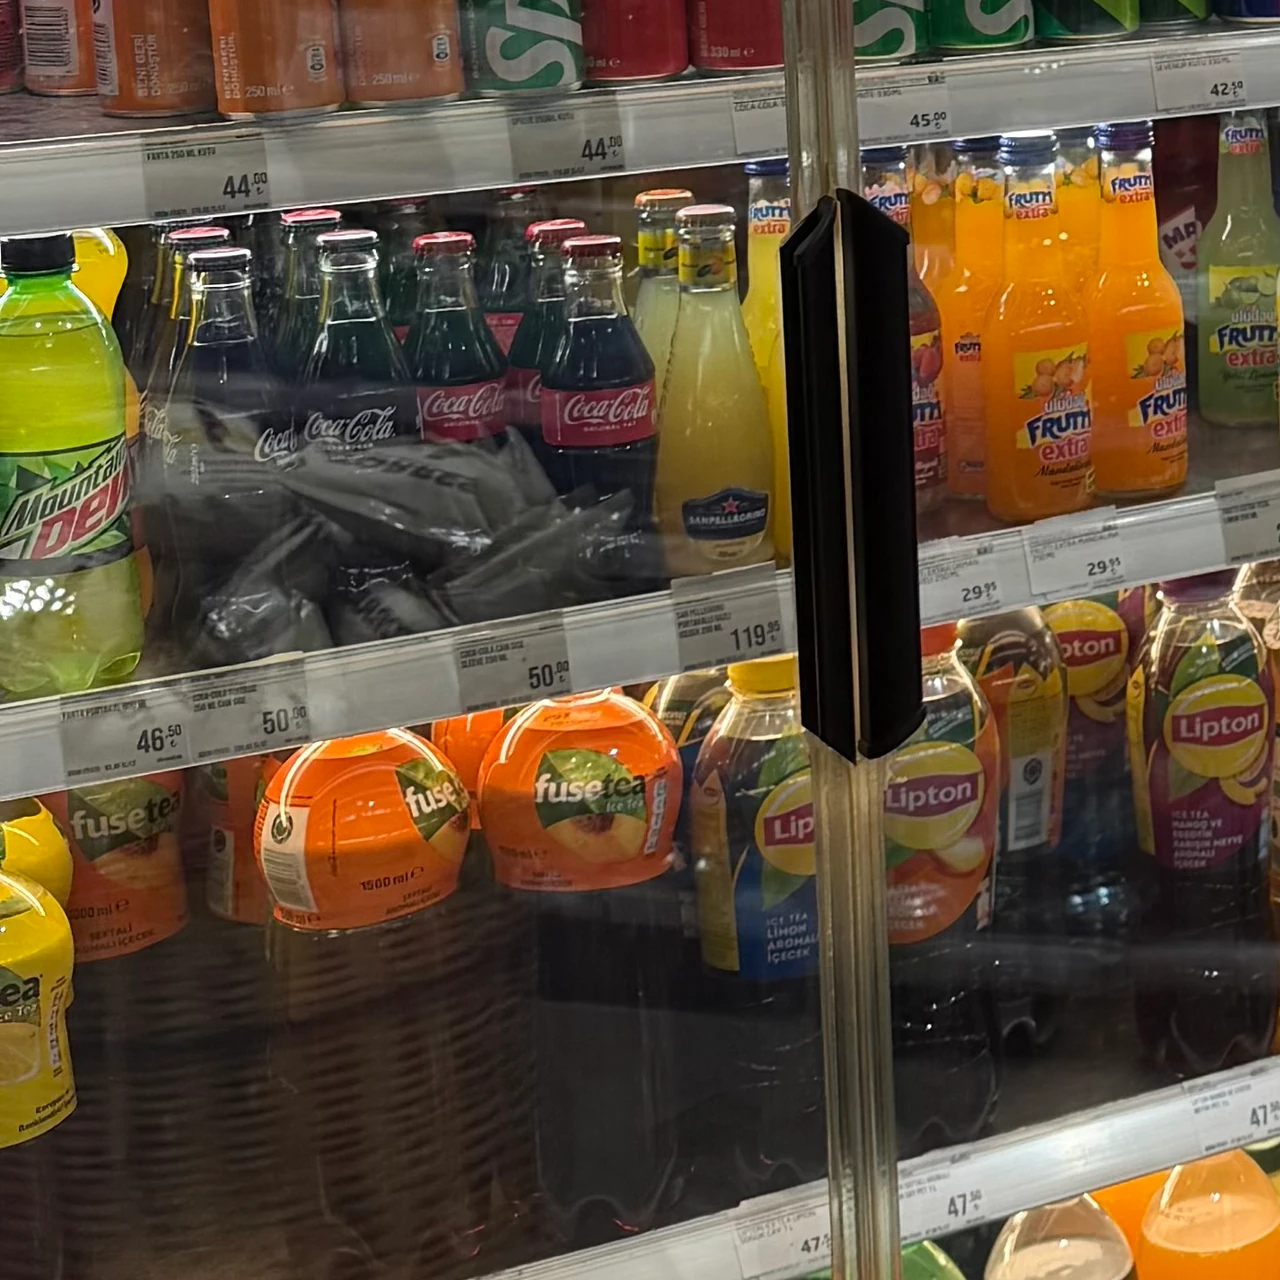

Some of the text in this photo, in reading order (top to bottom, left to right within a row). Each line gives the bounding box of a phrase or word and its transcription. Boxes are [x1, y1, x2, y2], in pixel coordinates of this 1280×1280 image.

[1118, 190, 1152, 204] extra
[1015, 206, 1050, 220] extra
[753, 221, 786, 235] extra
[1227, 348, 1276, 368] extra
[564, 385, 650, 424] Coca-Cola
[304, 405, 396, 443] Coca-Cola
[1039, 436, 1091, 463] extra
[1180, 712, 1260, 740] Lipton
[534, 769, 646, 806] fusetea
[885, 781, 972, 811] Lipton
[70, 792, 181, 841] fusetea
